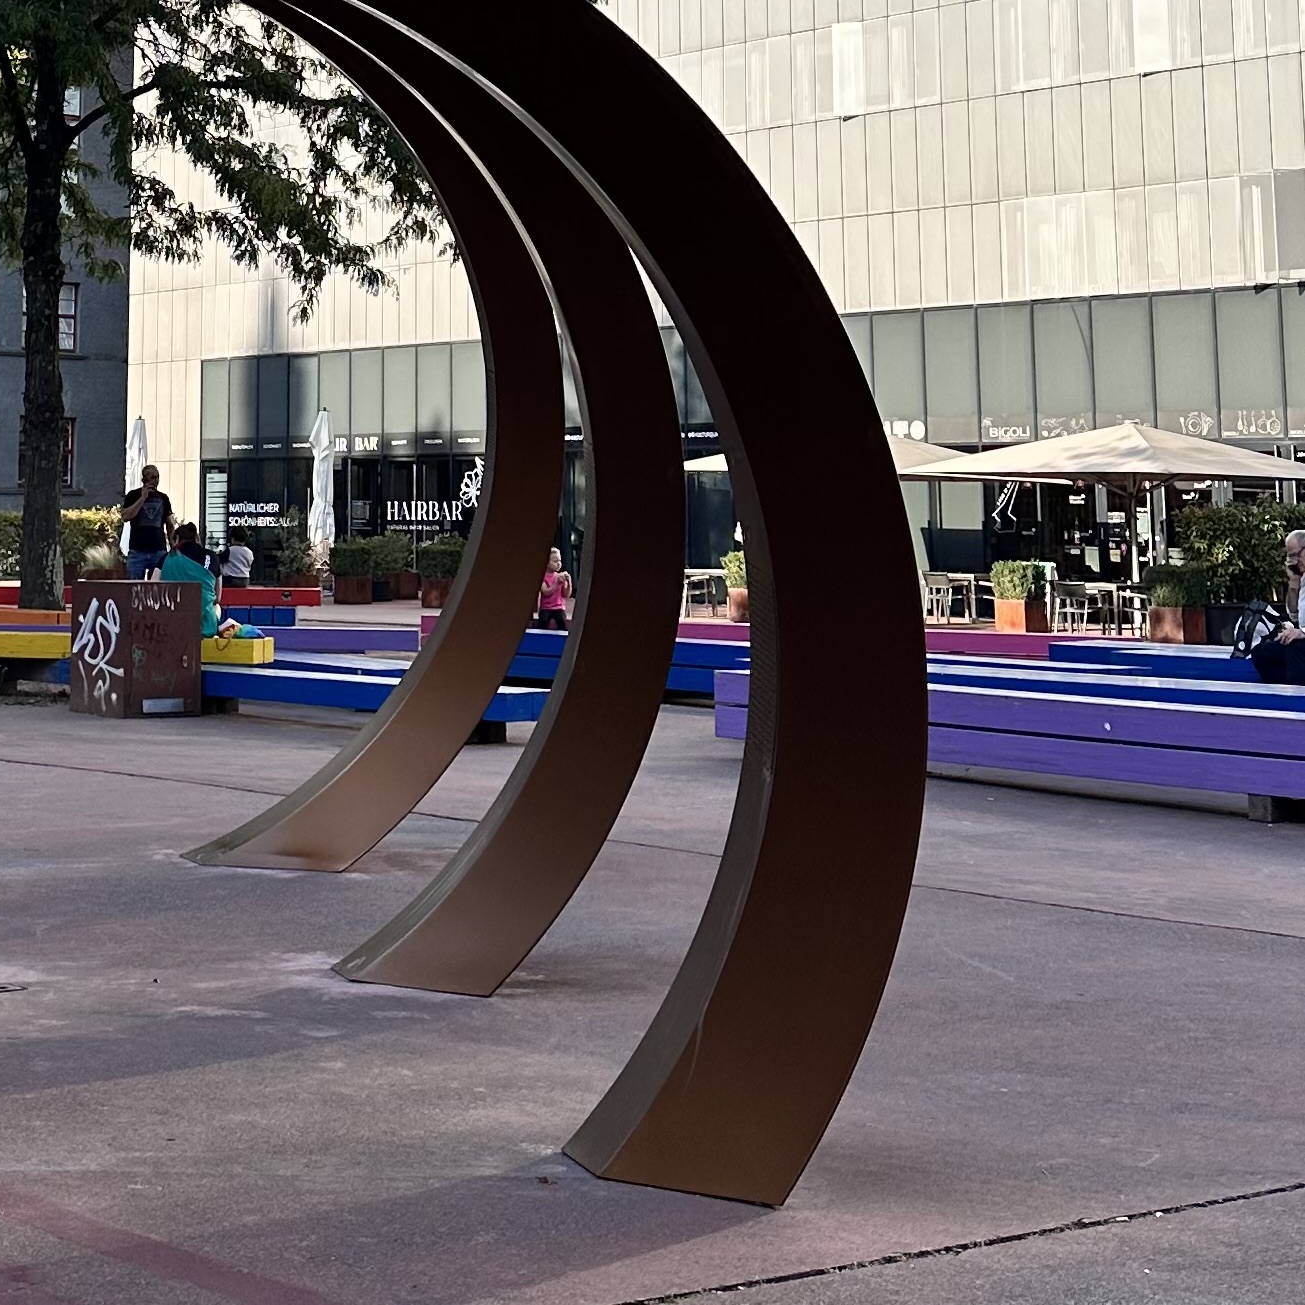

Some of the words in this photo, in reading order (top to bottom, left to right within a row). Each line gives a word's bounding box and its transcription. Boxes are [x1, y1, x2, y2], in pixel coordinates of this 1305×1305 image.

[989, 426, 1030, 438] BIGOLI
[354, 436, 378, 451] BAR
[228, 501, 280, 513] NATÜRLICHER
[386, 501, 463, 521] HAIRBAR
